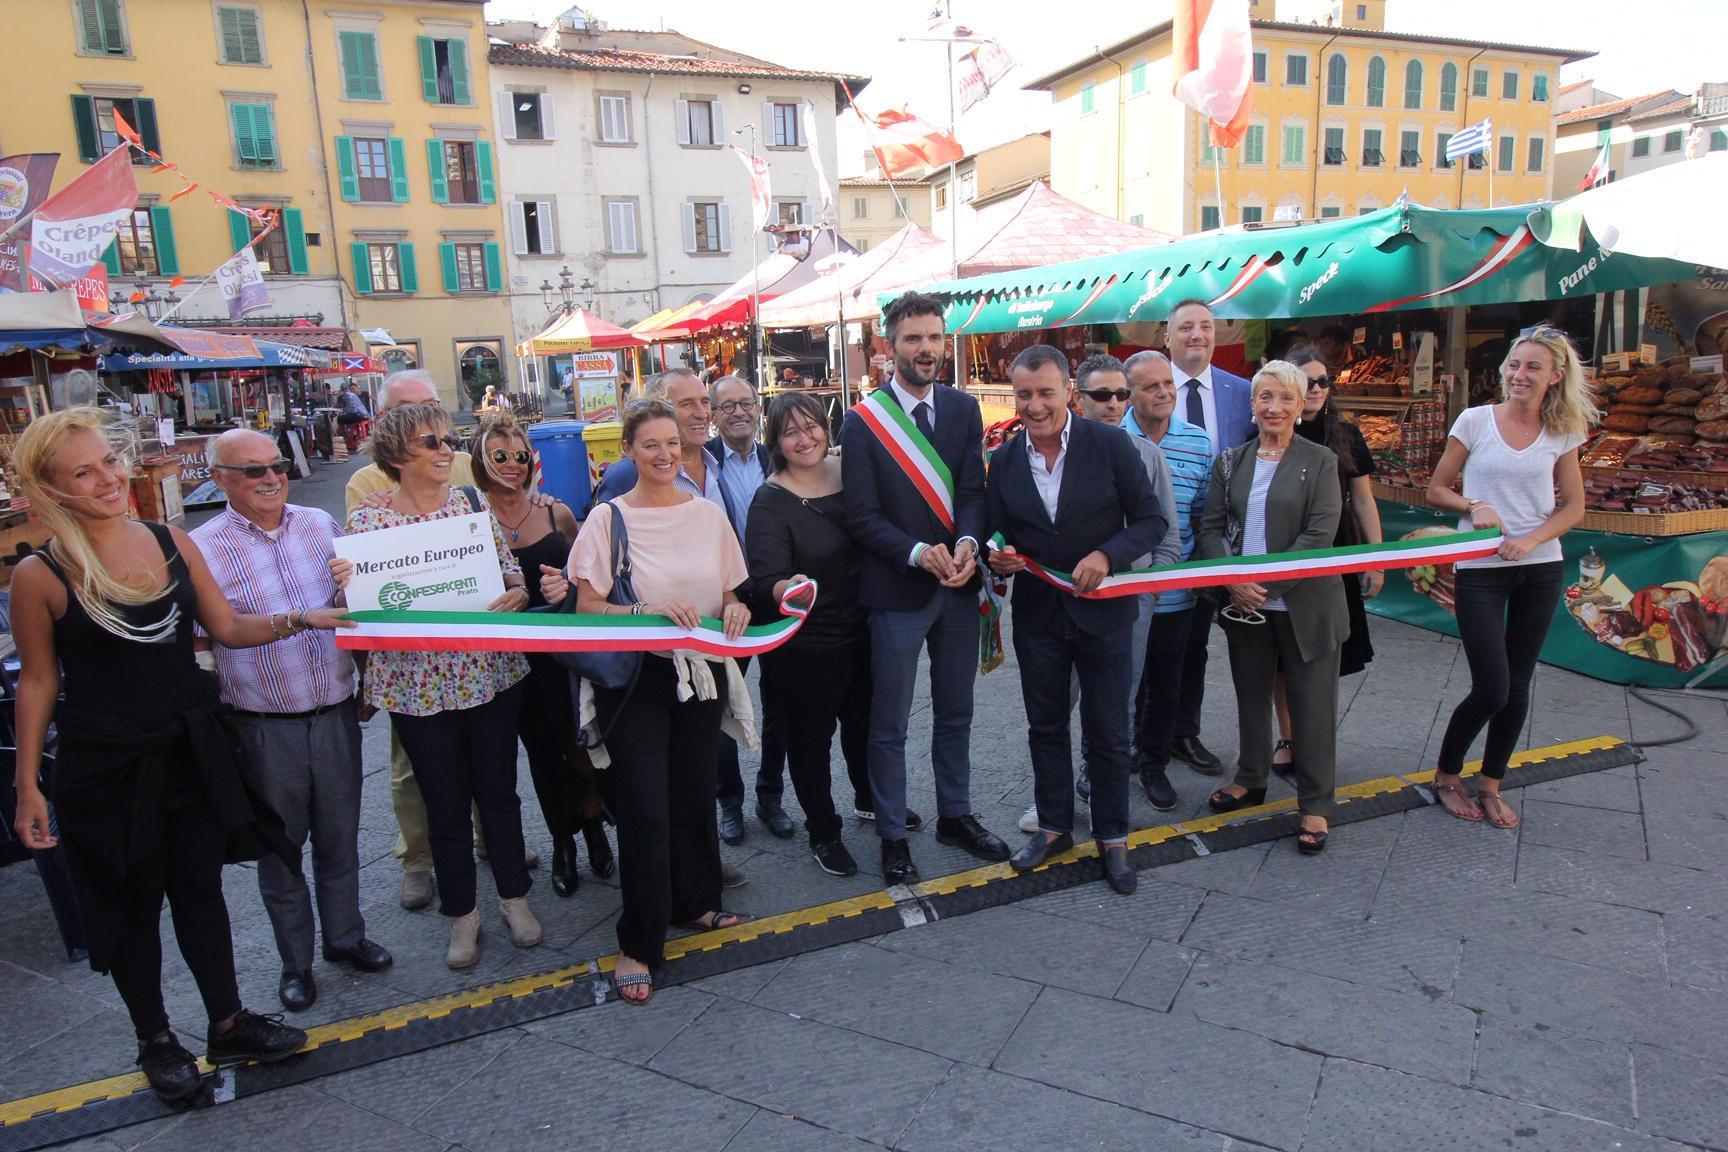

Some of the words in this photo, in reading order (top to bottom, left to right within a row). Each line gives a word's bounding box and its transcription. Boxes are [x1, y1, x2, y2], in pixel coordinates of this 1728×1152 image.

[38, 240, 101, 263] Oland
[1299, 262, 1339, 304] Speck
[1557, 256, 1597, 295] Pane
[128, 354, 176, 364] Specialità
[576, 360, 608, 371] CASSA
[356, 554, 420, 576] Mercato
[424, 543, 484, 563] Europeo
[390, 576, 478, 602] CONFESERCENTI
[457, 588, 479, 597] Prato
